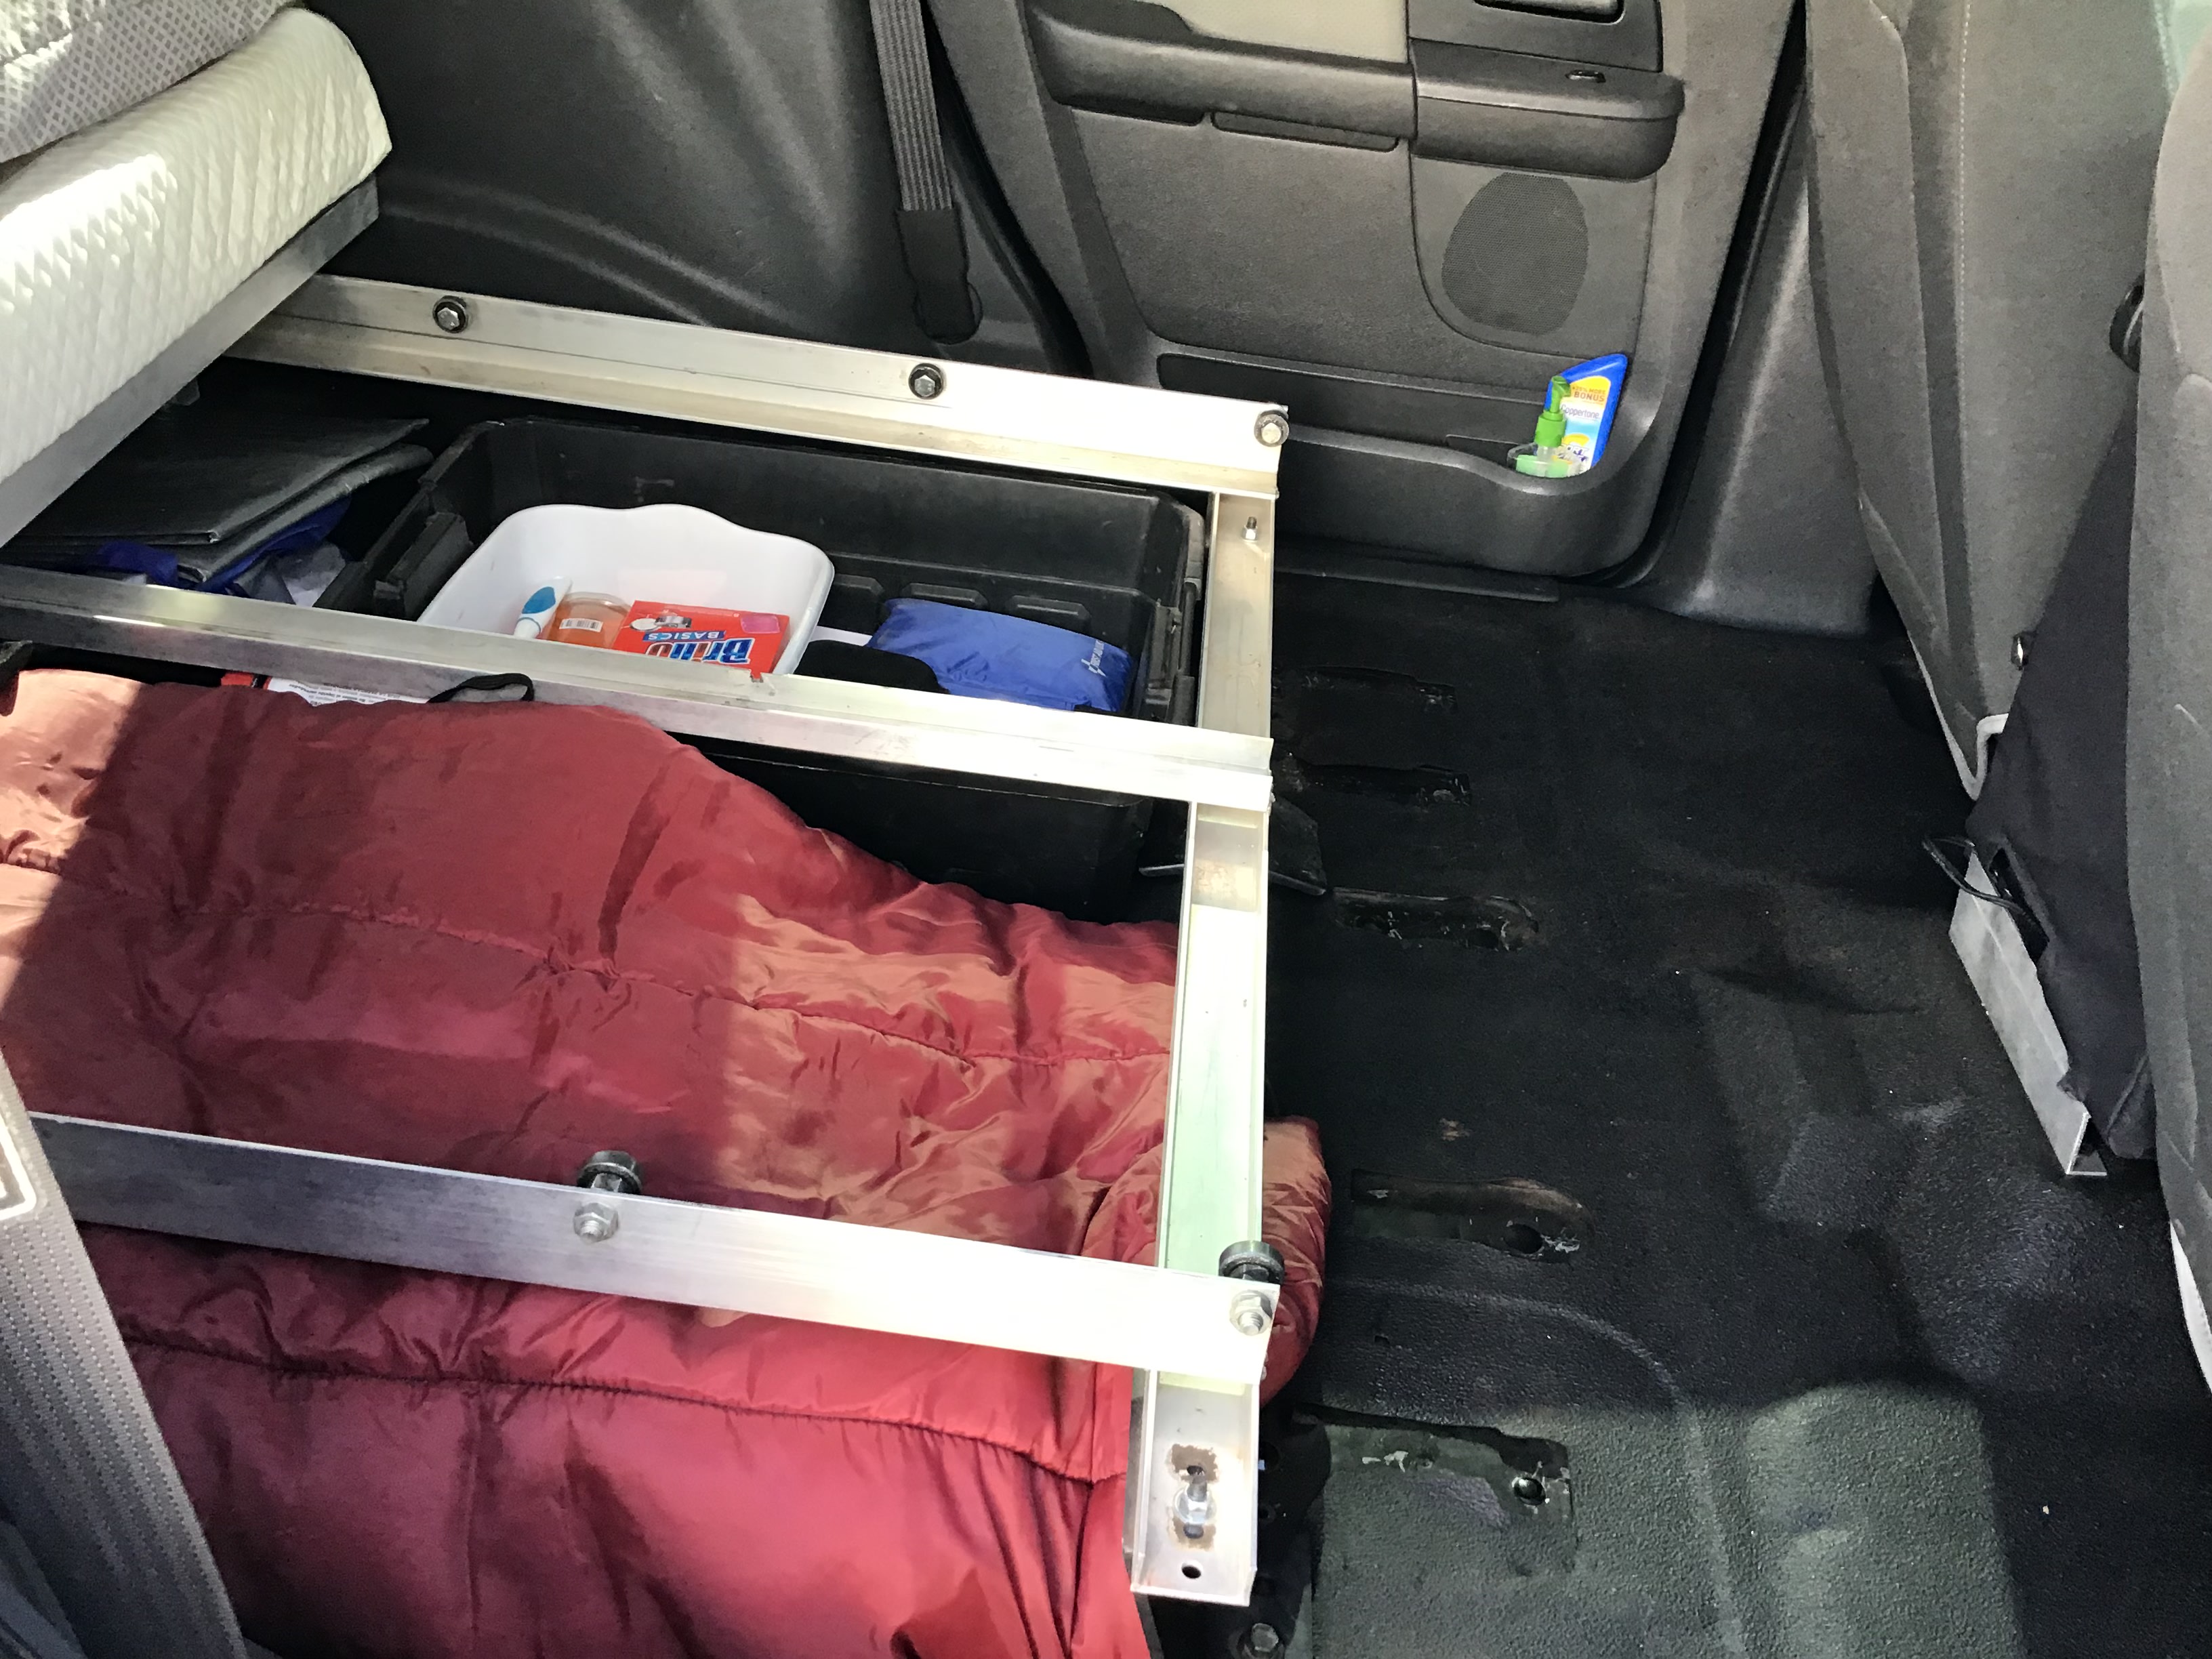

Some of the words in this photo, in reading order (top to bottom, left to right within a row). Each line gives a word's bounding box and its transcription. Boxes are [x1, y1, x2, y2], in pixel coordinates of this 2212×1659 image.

[1574, 391, 1605, 402] BONUS
[1561, 404, 1600, 419] Coppertone
[648, 632, 720, 640] BASICS
[645, 638, 755, 664] Brillo
